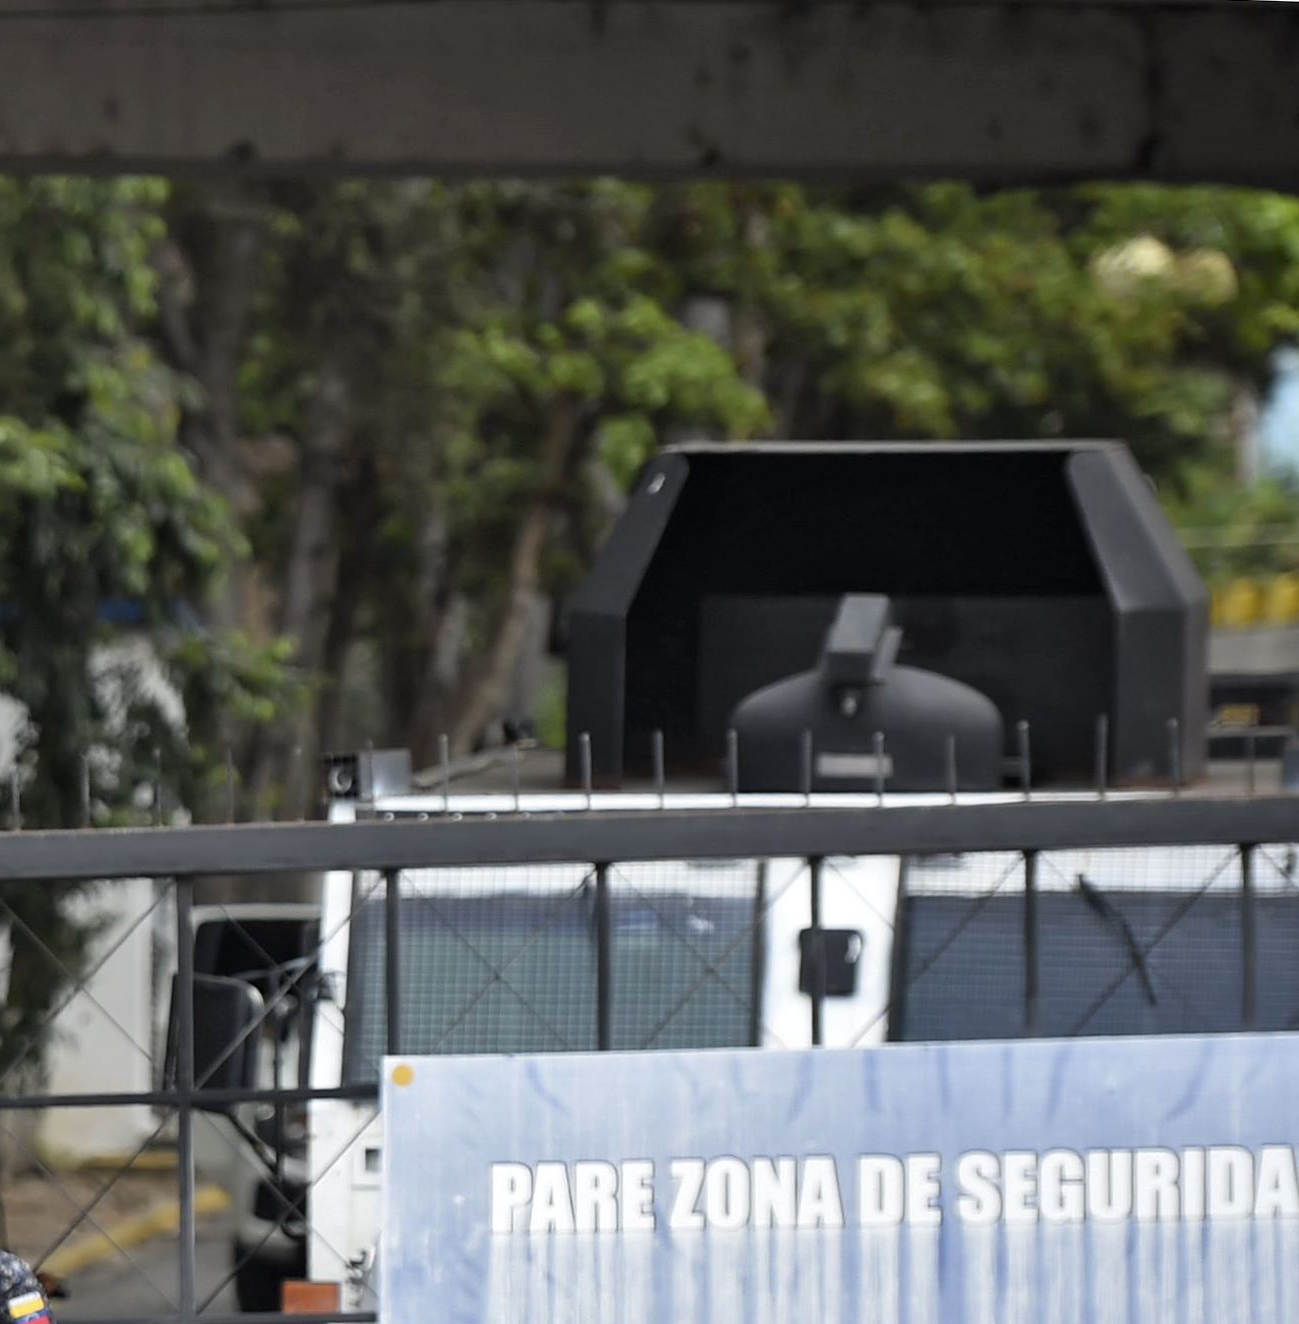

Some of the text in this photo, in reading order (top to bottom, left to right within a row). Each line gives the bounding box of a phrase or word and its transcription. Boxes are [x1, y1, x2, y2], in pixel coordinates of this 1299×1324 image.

[491, 1158, 656, 1234] PARE
[669, 1154, 845, 1231] ZONA
[857, 1151, 942, 1227] DE
